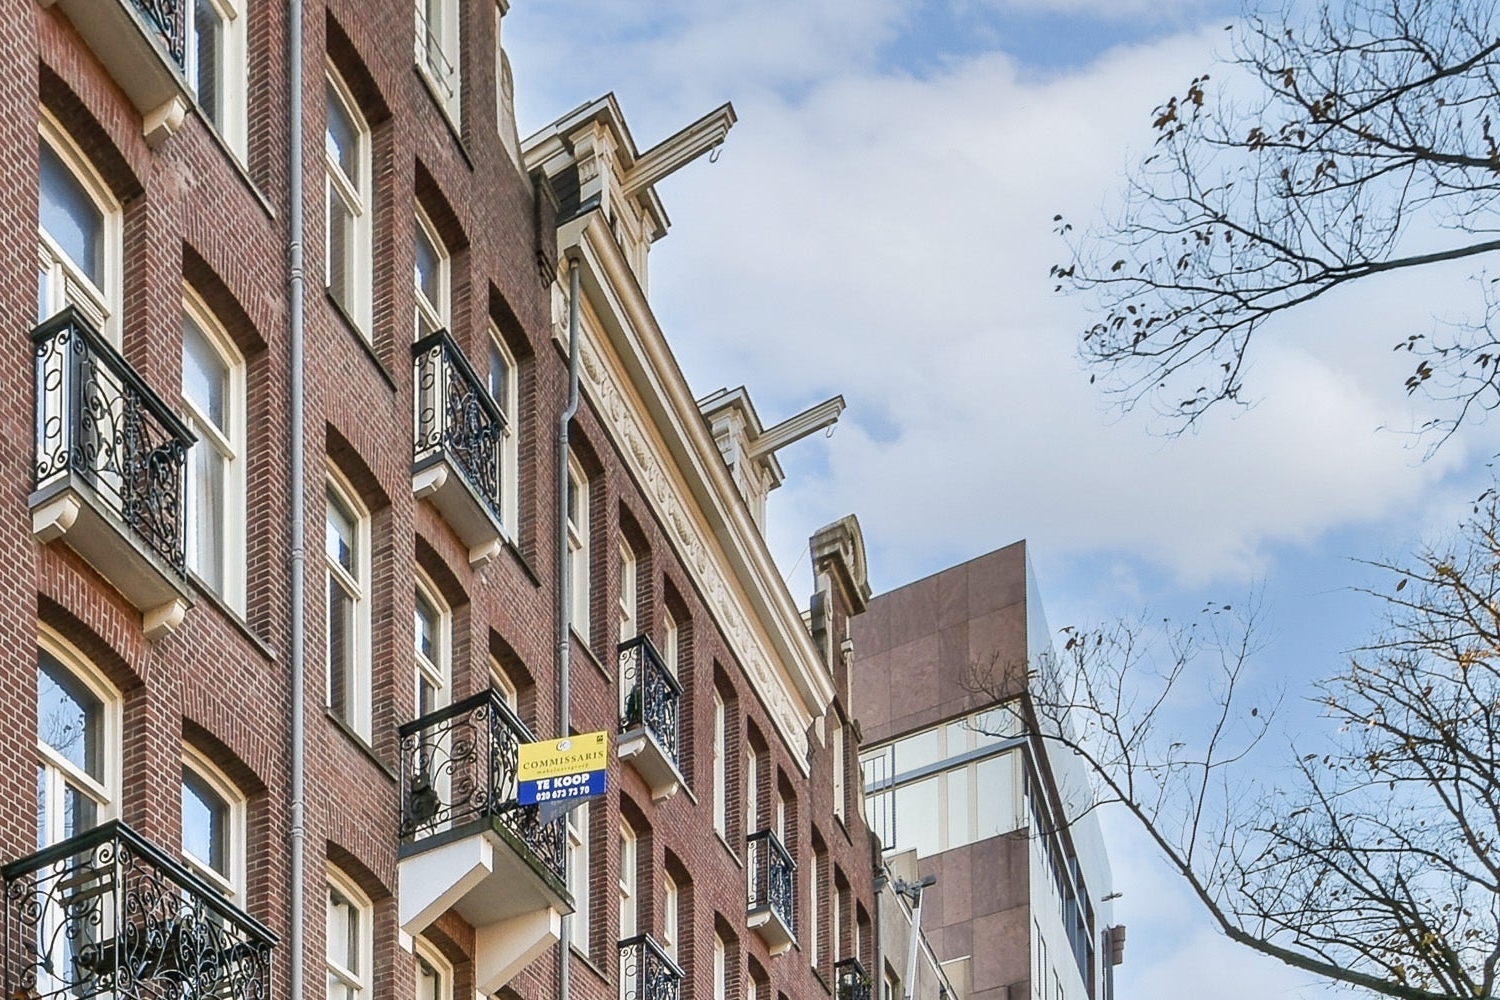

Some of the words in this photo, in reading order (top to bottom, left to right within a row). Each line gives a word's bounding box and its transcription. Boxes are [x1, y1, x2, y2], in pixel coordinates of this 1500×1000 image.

[523, 751, 604, 769] COMMISSARIS
[536, 779, 550, 790] TE
[554, 773, 590, 788] KOOP
[536, 791, 551, 801] 020
[552, 789, 566, 799] 673
[568, 787, 578, 796] 73
[579, 785, 590, 795] 70
